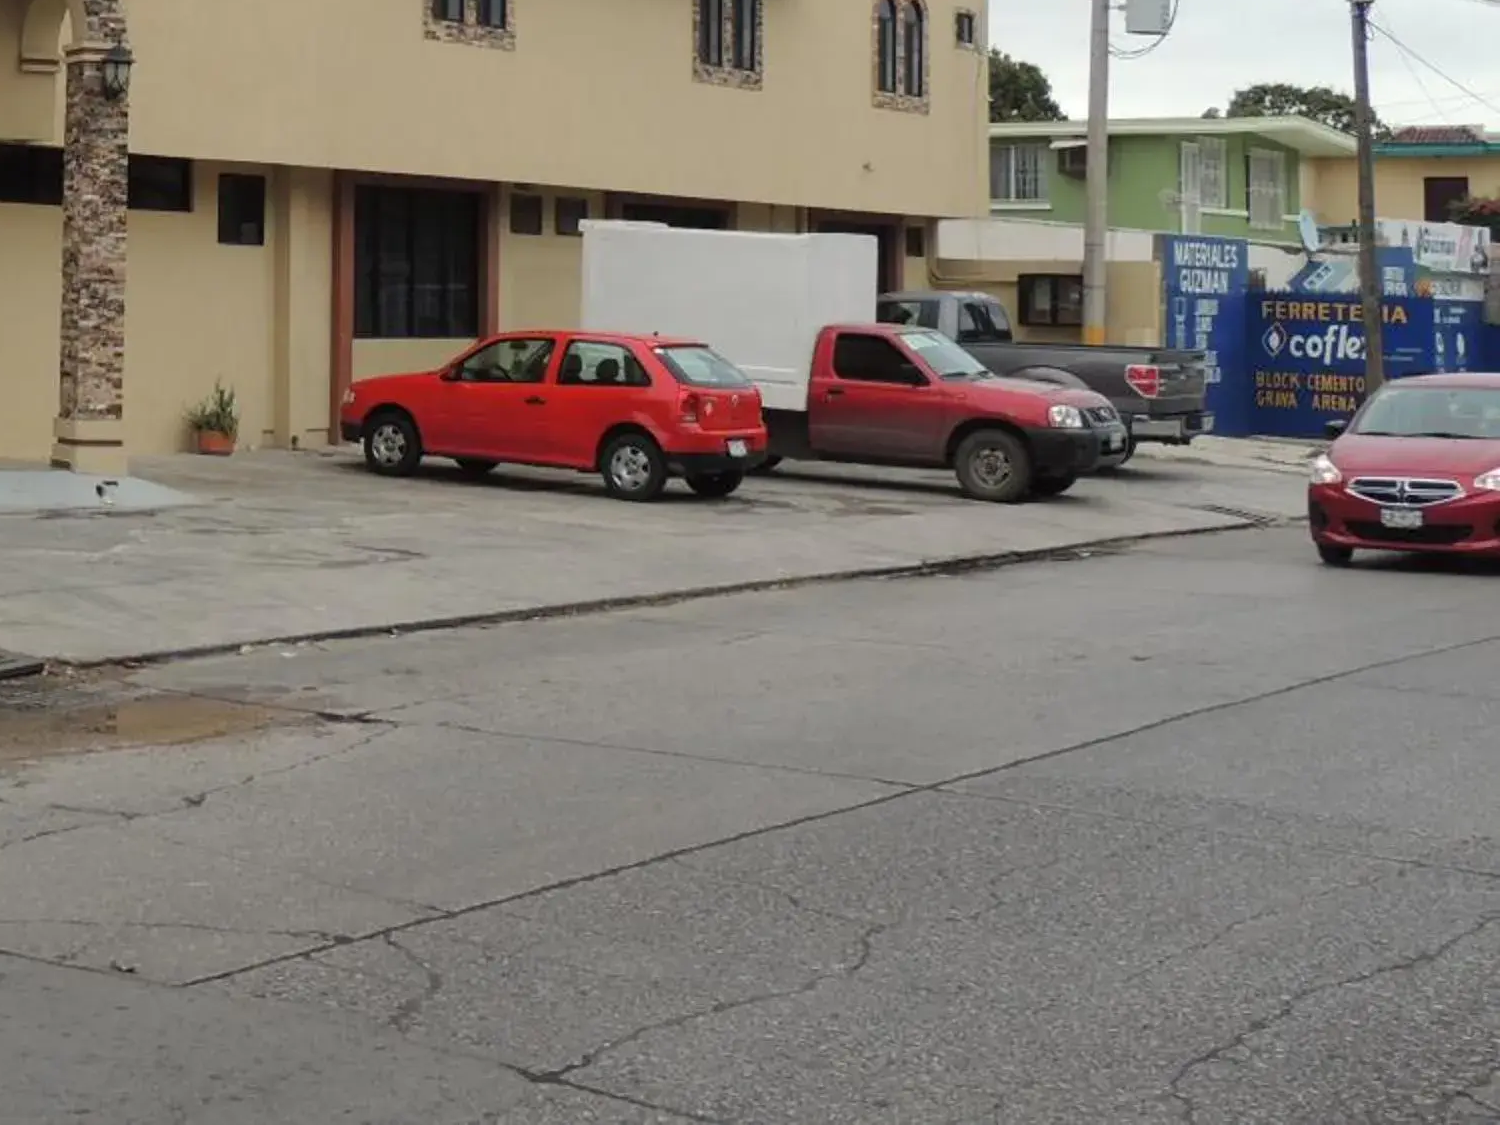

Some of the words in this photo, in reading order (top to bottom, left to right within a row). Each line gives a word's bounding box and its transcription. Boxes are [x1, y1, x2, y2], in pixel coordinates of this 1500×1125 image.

[1173, 240, 1239, 268] MATERIALES
[1180, 268, 1230, 294] GUZMAN
[1261, 300, 1408, 324] FERRETEIA
[1256, 371, 1301, 389] BLOCK
[1307, 373, 1366, 393] CEMENTO
[1256, 390, 1298, 409] GRAVA
[1312, 393, 1357, 412] ARENA
